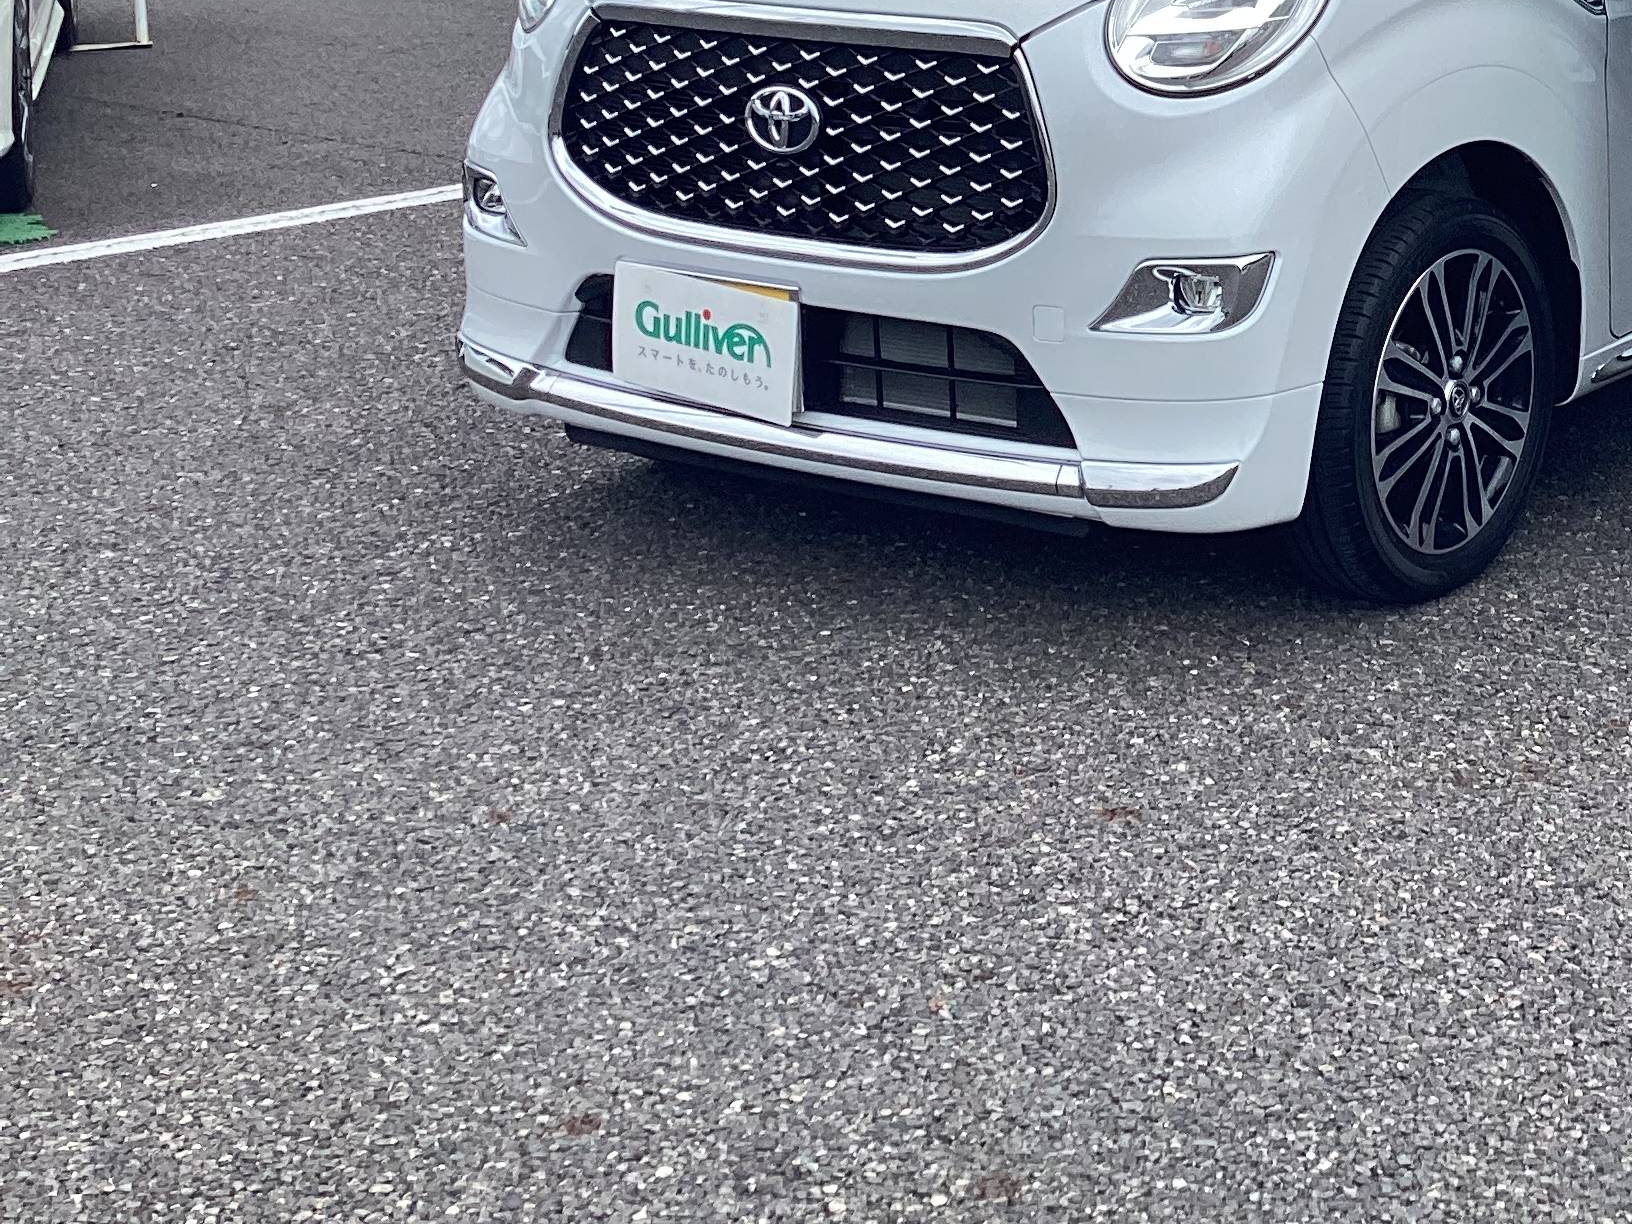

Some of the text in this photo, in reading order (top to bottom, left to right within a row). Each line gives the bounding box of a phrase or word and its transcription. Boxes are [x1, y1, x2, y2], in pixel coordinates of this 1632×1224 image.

[635, 300, 772, 368] Gulliver
[638, 345, 769, 391] スマートを、たのしもう。
